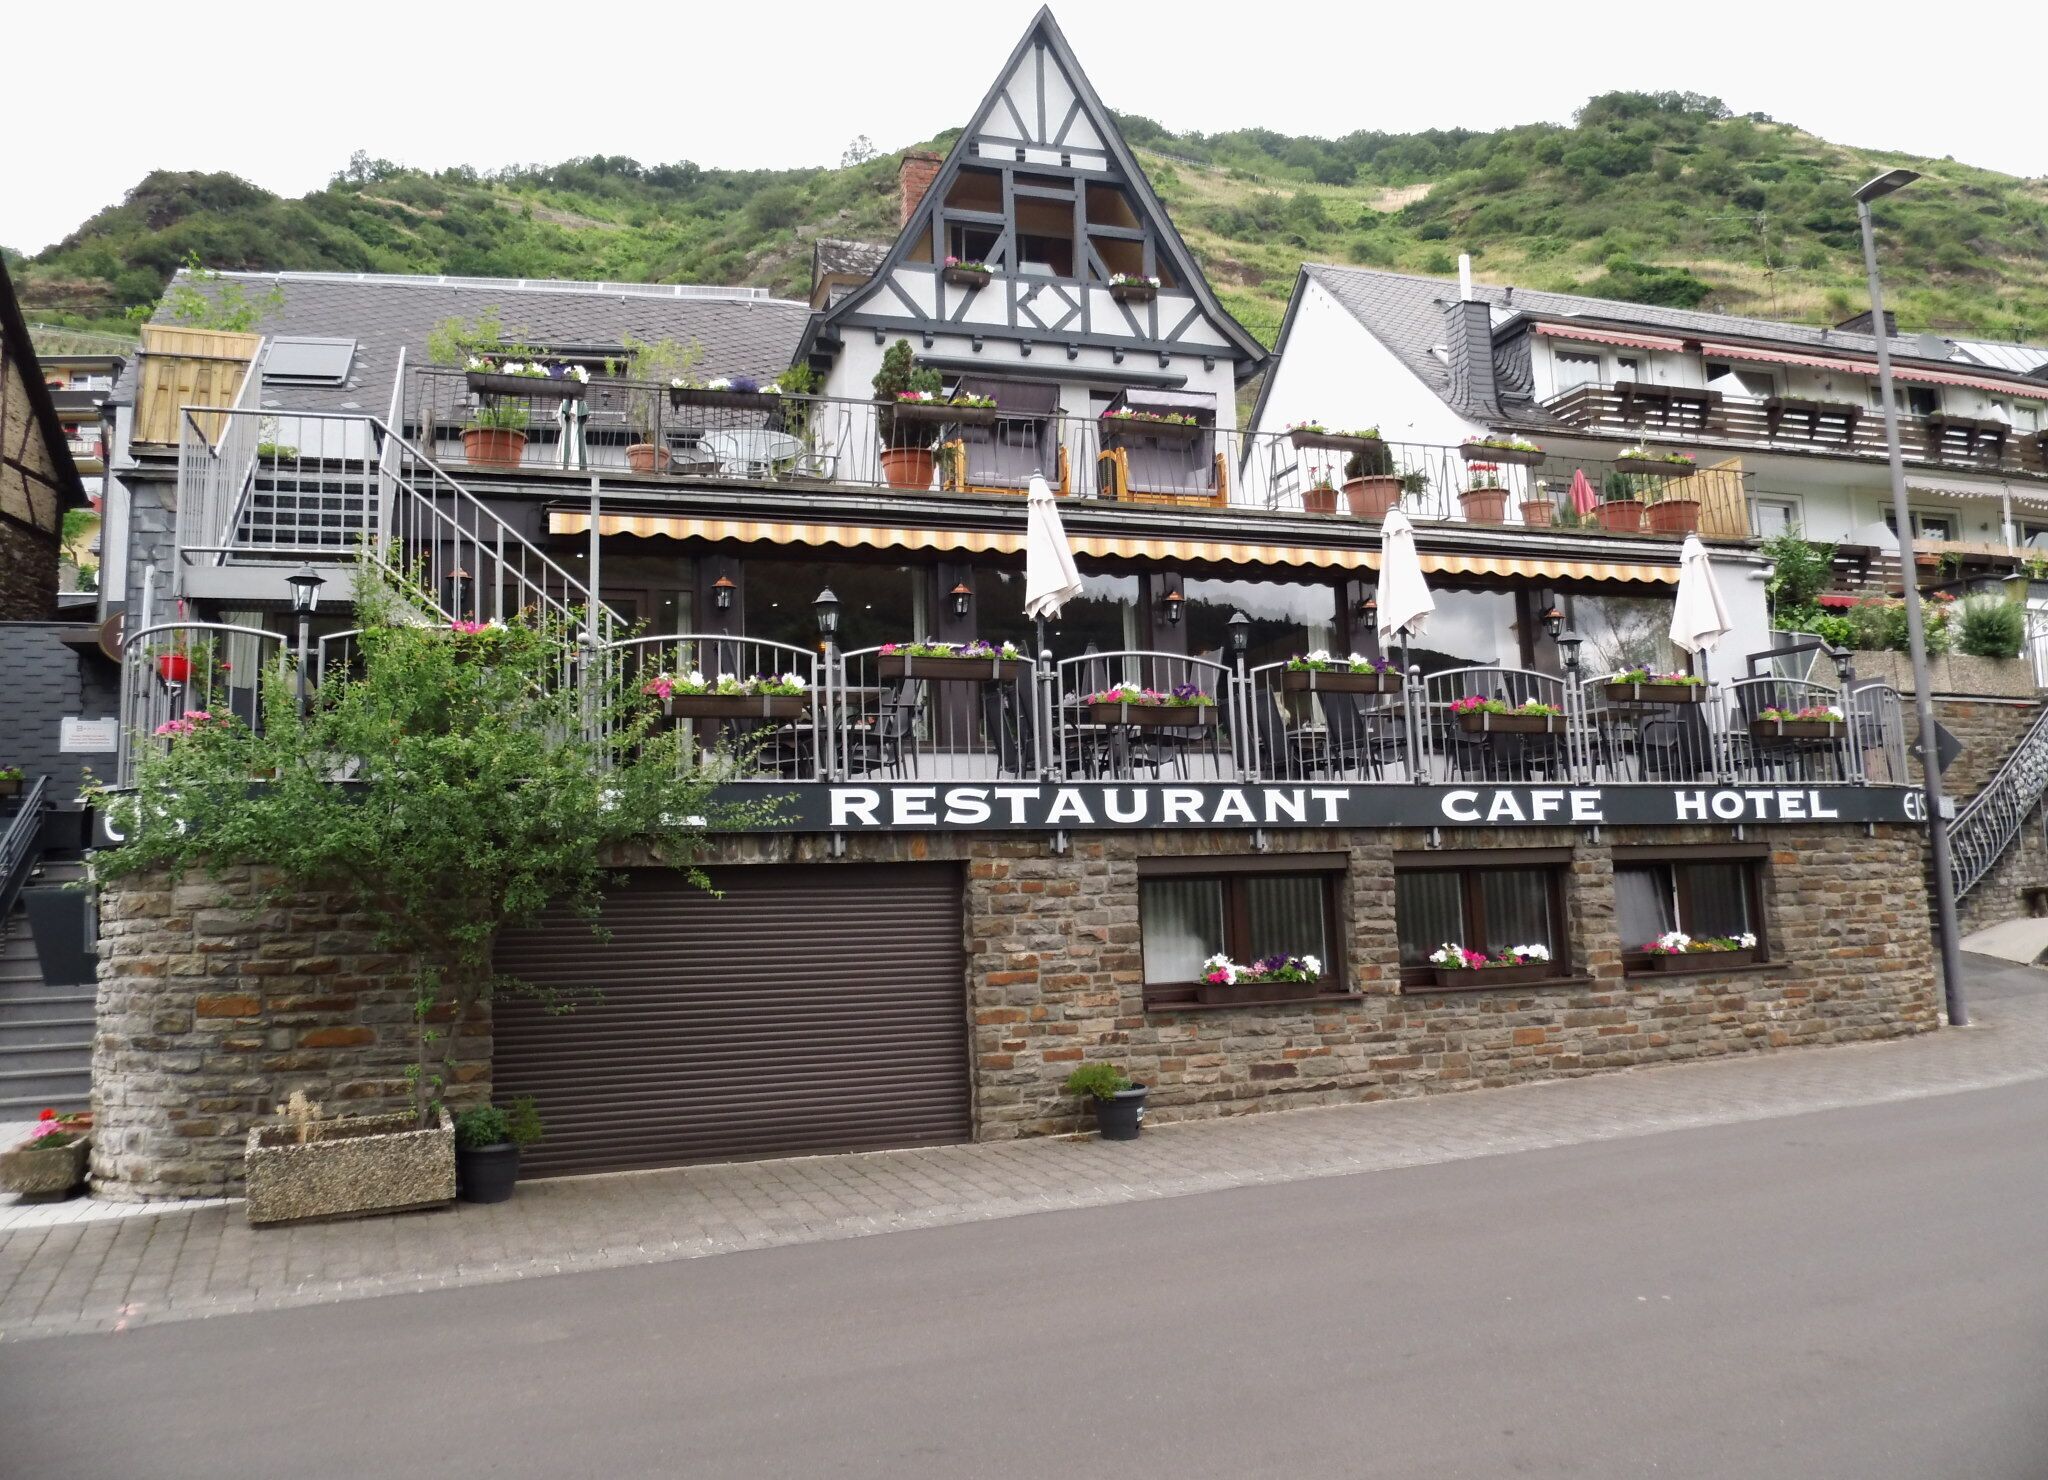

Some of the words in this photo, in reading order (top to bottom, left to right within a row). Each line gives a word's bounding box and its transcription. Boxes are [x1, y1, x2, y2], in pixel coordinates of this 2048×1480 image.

[828, 787, 1350, 826] RESTAURANT
[1440, 789, 1604, 822] CAFE
[1674, 789, 1839, 821] HOTEL
